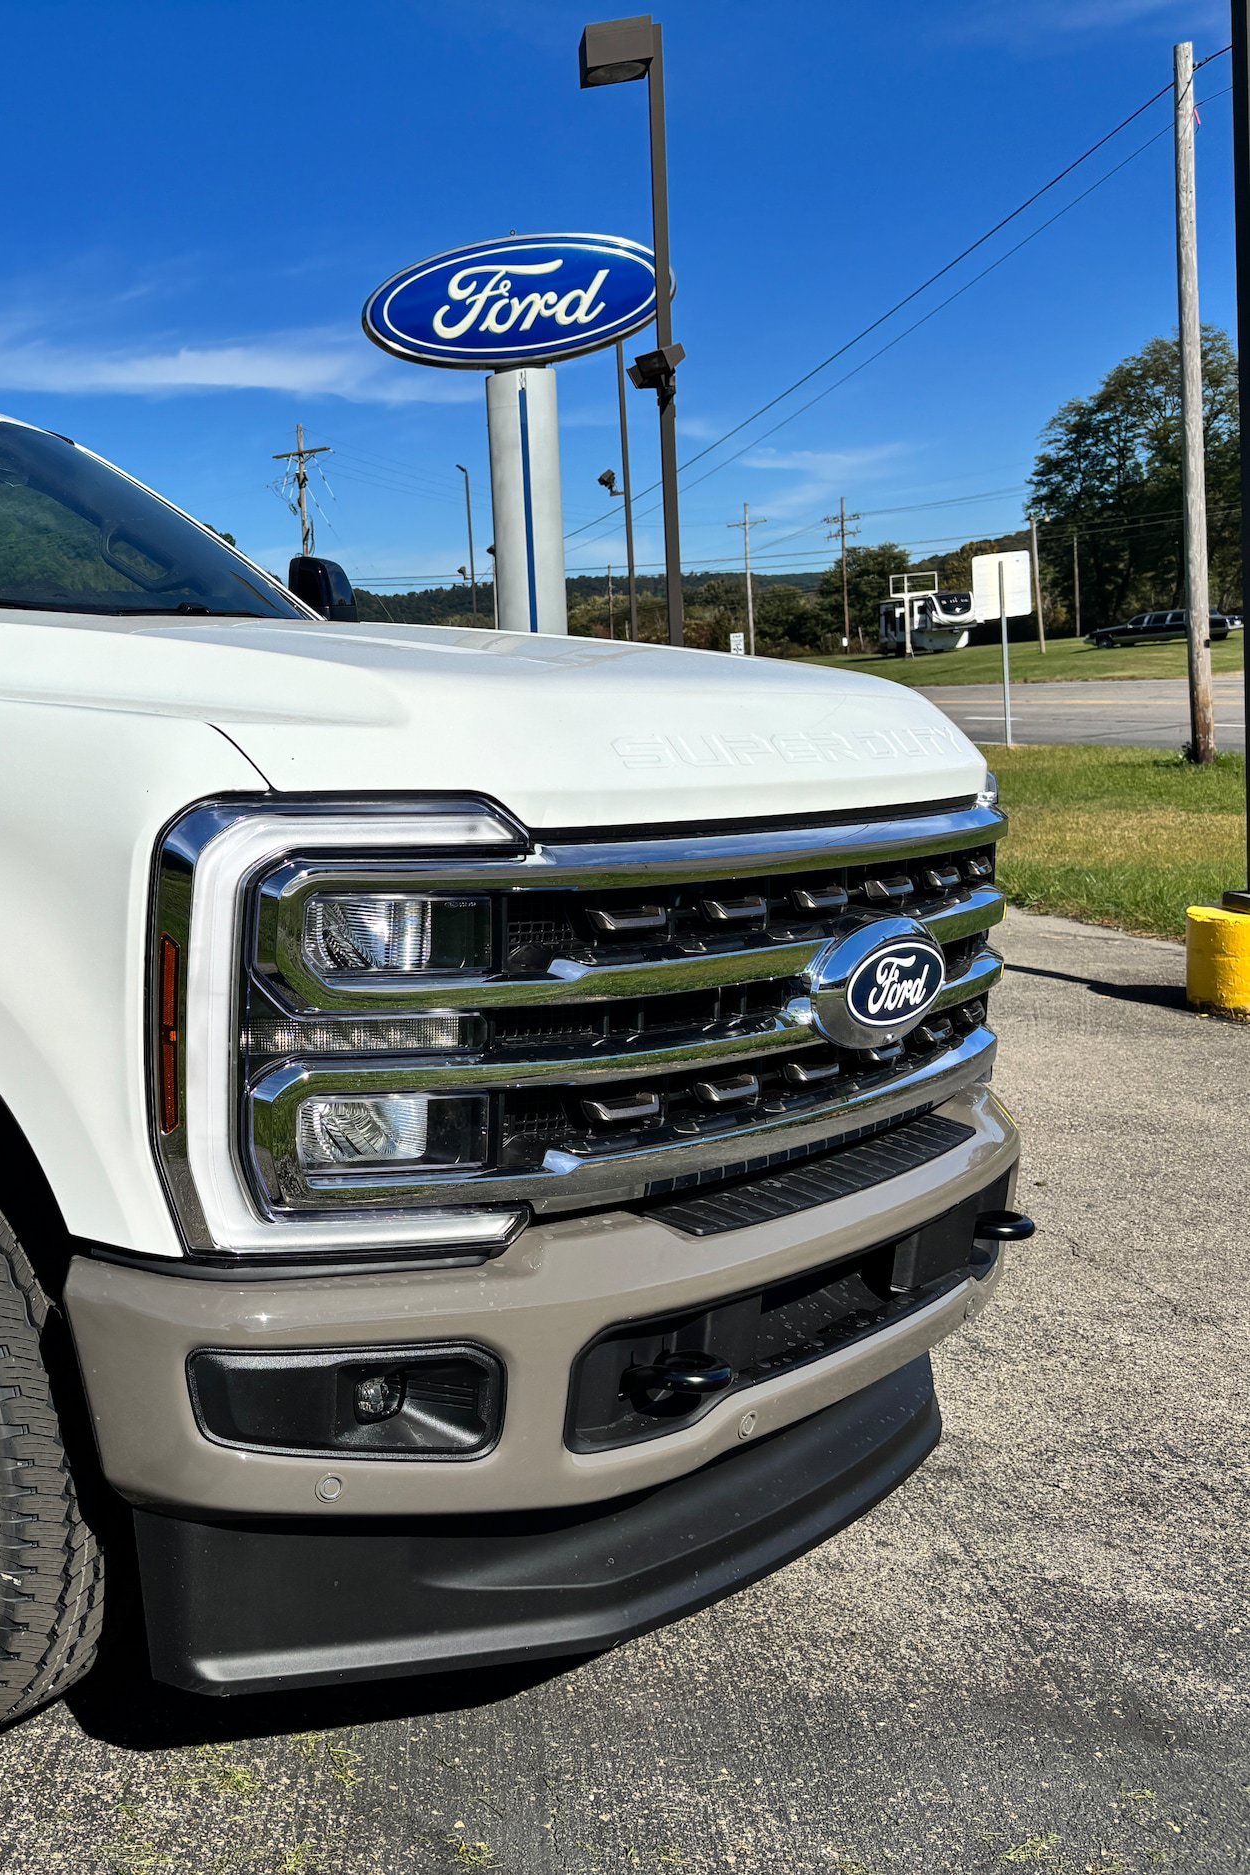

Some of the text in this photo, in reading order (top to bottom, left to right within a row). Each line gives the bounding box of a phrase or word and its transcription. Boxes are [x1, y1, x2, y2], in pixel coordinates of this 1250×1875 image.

[433, 259, 610, 339] Ford
[609, 726, 964, 769] SUPER DUTY
[867, 954, 930, 1014] Ford
